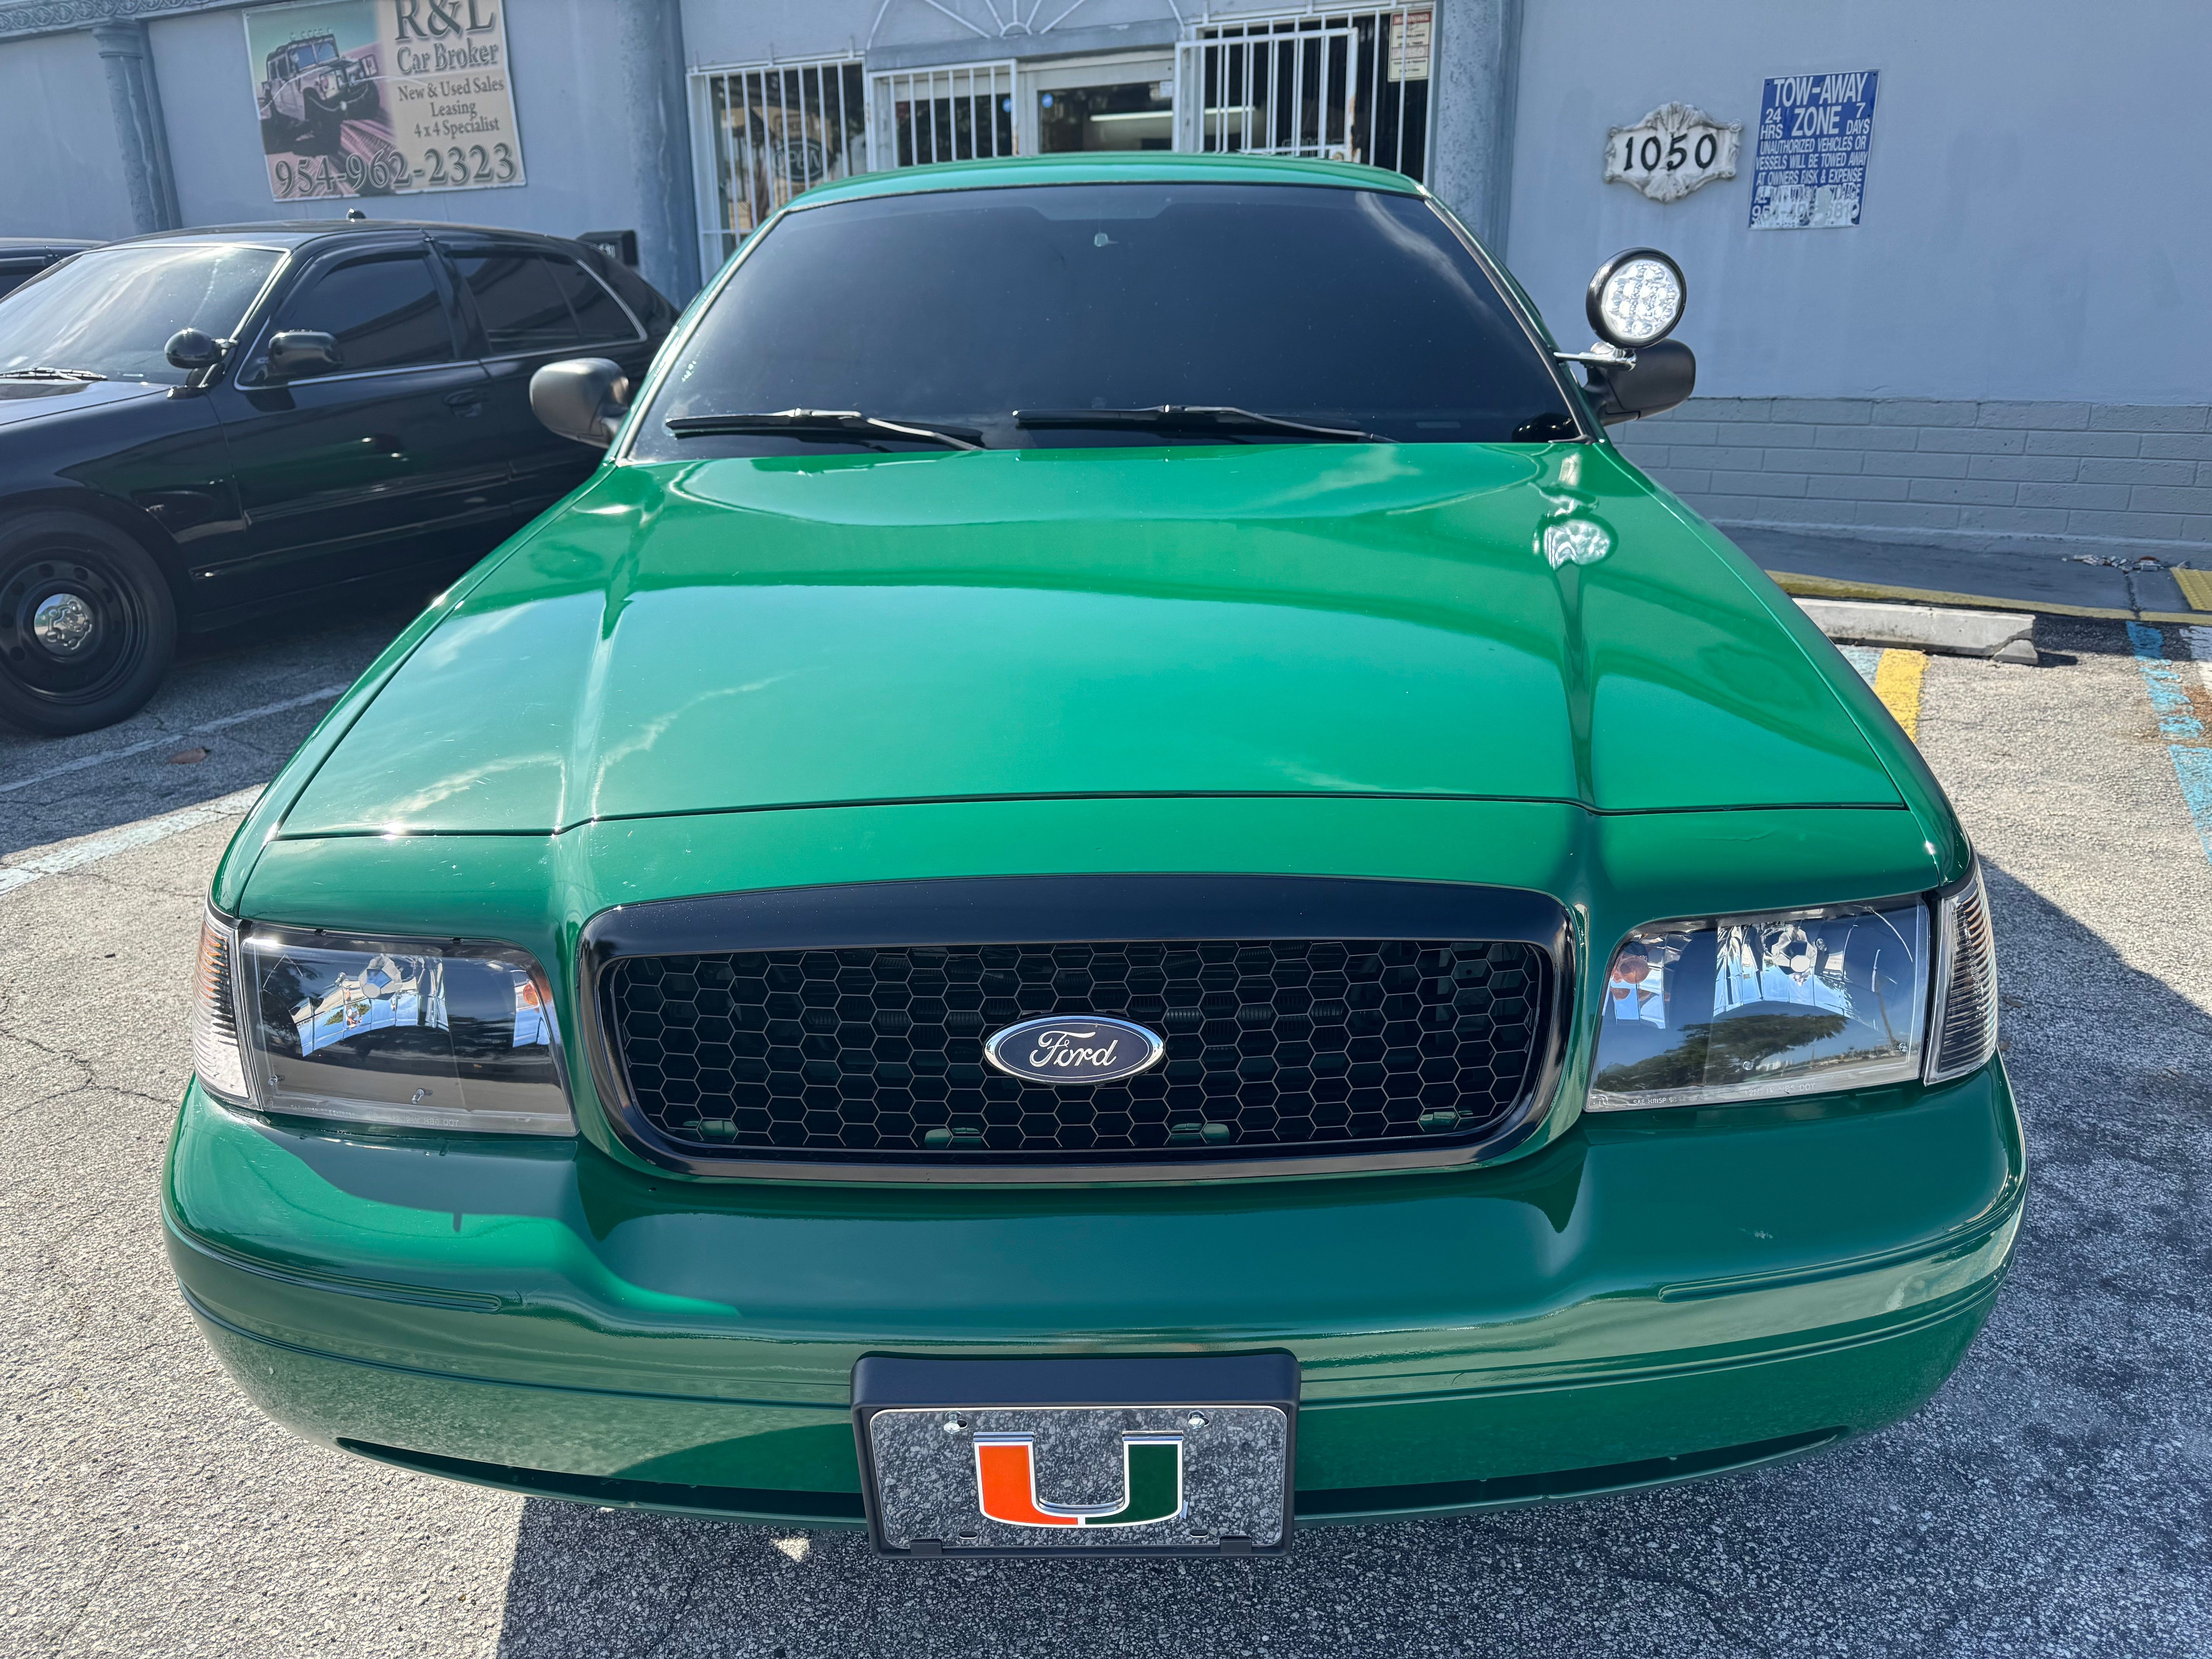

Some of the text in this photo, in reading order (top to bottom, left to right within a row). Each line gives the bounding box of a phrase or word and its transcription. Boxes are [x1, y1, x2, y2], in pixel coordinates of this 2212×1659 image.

[395, 0, 495, 40] R&L
[397, 37, 498, 73] Car Broker
[397, 76, 505, 101] New & Used Sales
[1774, 73, 1869, 107] TOW-AWAY
[429, 100, 477, 120] Leasing
[1765, 108, 1781, 124] 24
[1791, 106, 1842, 136] ZONE
[1856, 103, 1866, 118] 7
[442, 115, 500, 139] Specialist
[1760, 124, 1783, 139] HRS
[1846, 119, 1870, 135] DAYS
[1623, 133, 1717, 171] 1050
[1760, 136, 1867, 155] UNAUTHORIZED VEHICLES OR
[275, 142, 516, 194] 954-962-2323
[1756, 151, 1869, 170] VESSELS WILL BE TOWED AWAY
[1756, 167, 1863, 185] AT OWNERS RISK & EXPENSE
[1029, 1030, 1118, 1067] Ford
[973, 1430, 1184, 1528] U
